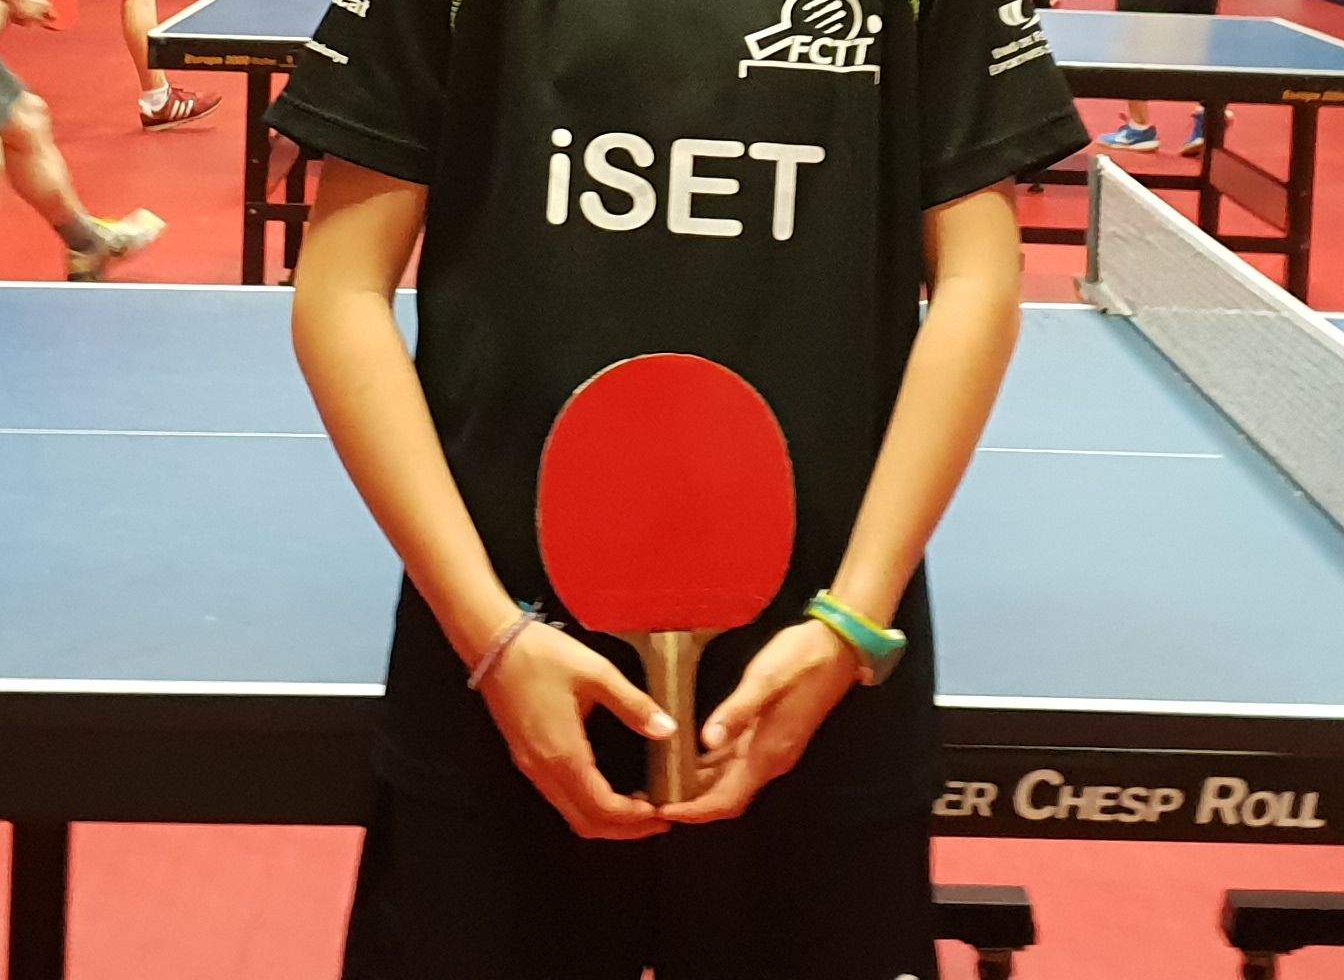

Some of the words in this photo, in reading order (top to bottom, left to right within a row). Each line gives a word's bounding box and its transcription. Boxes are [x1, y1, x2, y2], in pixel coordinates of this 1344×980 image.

[787, 34, 875, 67] FCTT
[546, 128, 826, 241] iSET
[1012, 768, 1185, 823] CHESP
[1194, 776, 1327, 829] ROLL
